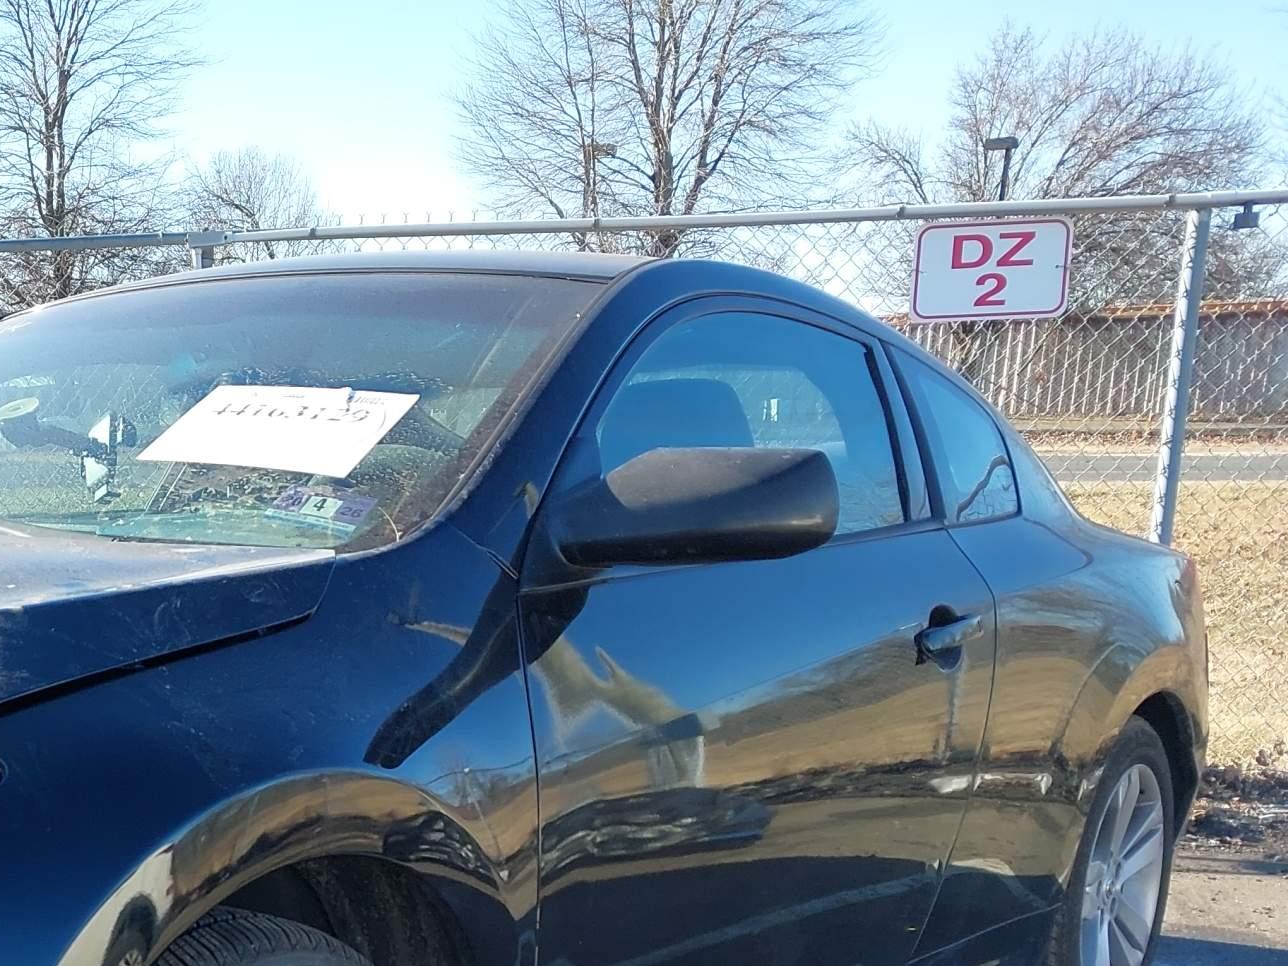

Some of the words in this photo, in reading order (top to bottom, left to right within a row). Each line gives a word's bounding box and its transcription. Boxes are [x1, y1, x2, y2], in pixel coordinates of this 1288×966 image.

[951, 231, 1036, 269] DZ
[973, 273, 1007, 307] 2
[313, 498, 328, 512] 4
[340, 506, 364, 518] 26
